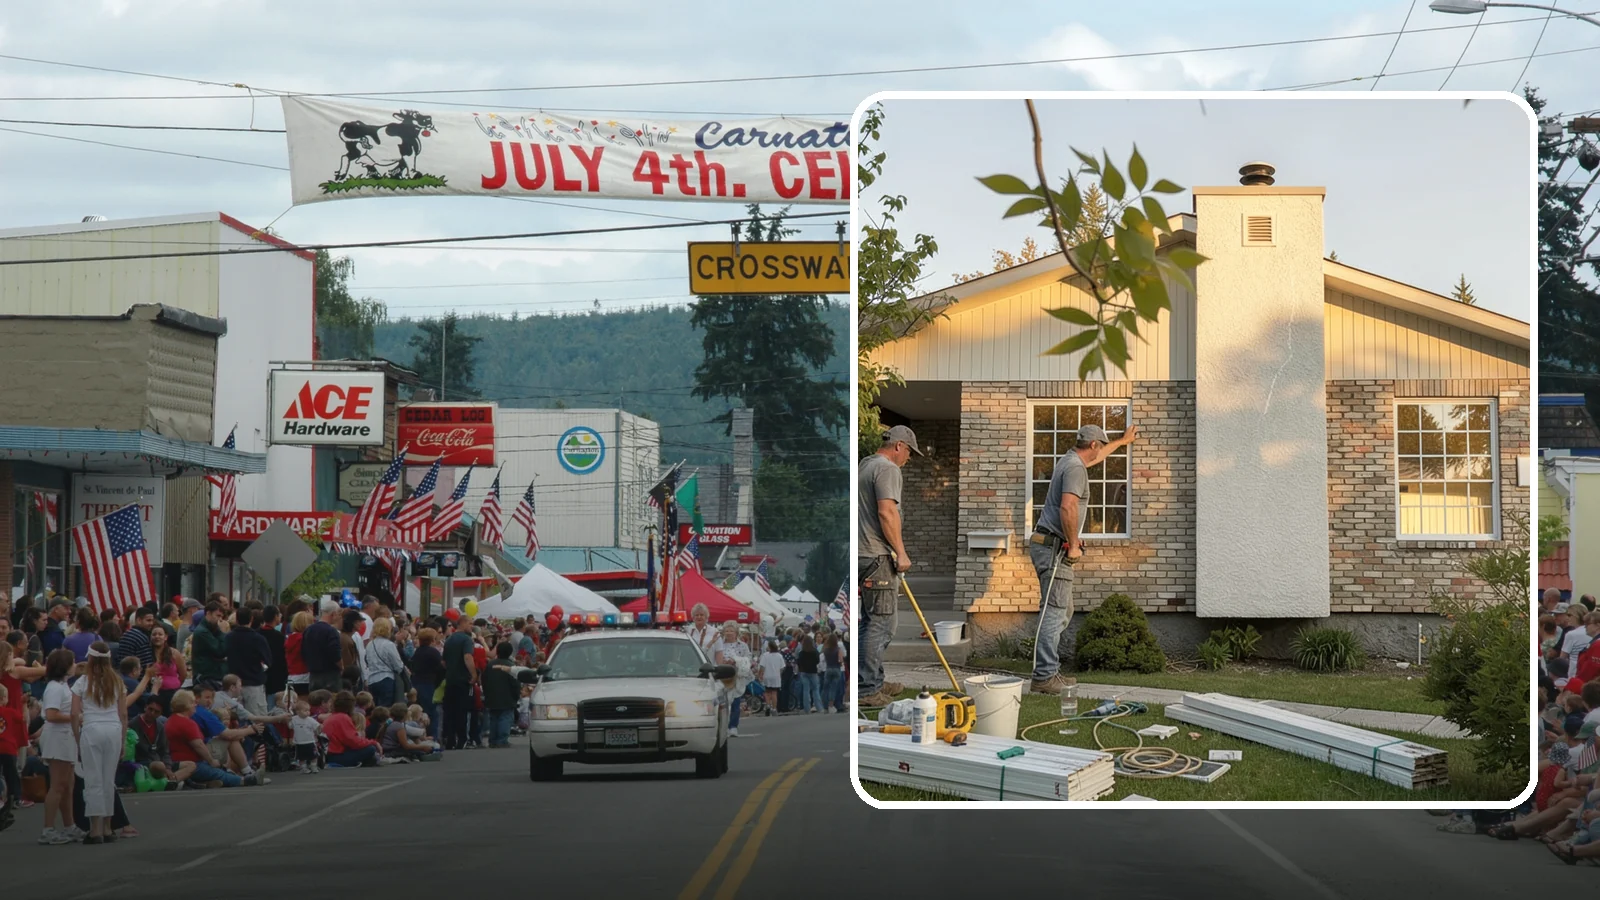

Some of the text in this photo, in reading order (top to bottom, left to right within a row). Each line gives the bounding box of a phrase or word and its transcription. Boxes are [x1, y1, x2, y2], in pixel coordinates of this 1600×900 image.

[481, 141, 605, 192] JULY
[632, 150, 746, 197] 4th.
[697, 254, 850, 280] CROSSWA
[283, 380, 373, 419] ACE
[406, 409, 485, 422] CEDAR LOG
[283, 421, 370, 436] Hardware
[95, 485, 124, 495] Vincent
[126, 486, 136, 494] de
[138, 486, 155, 495] Paul
[688, 526, 741, 535] CRNATION
[699, 535, 730, 543] GLASS
